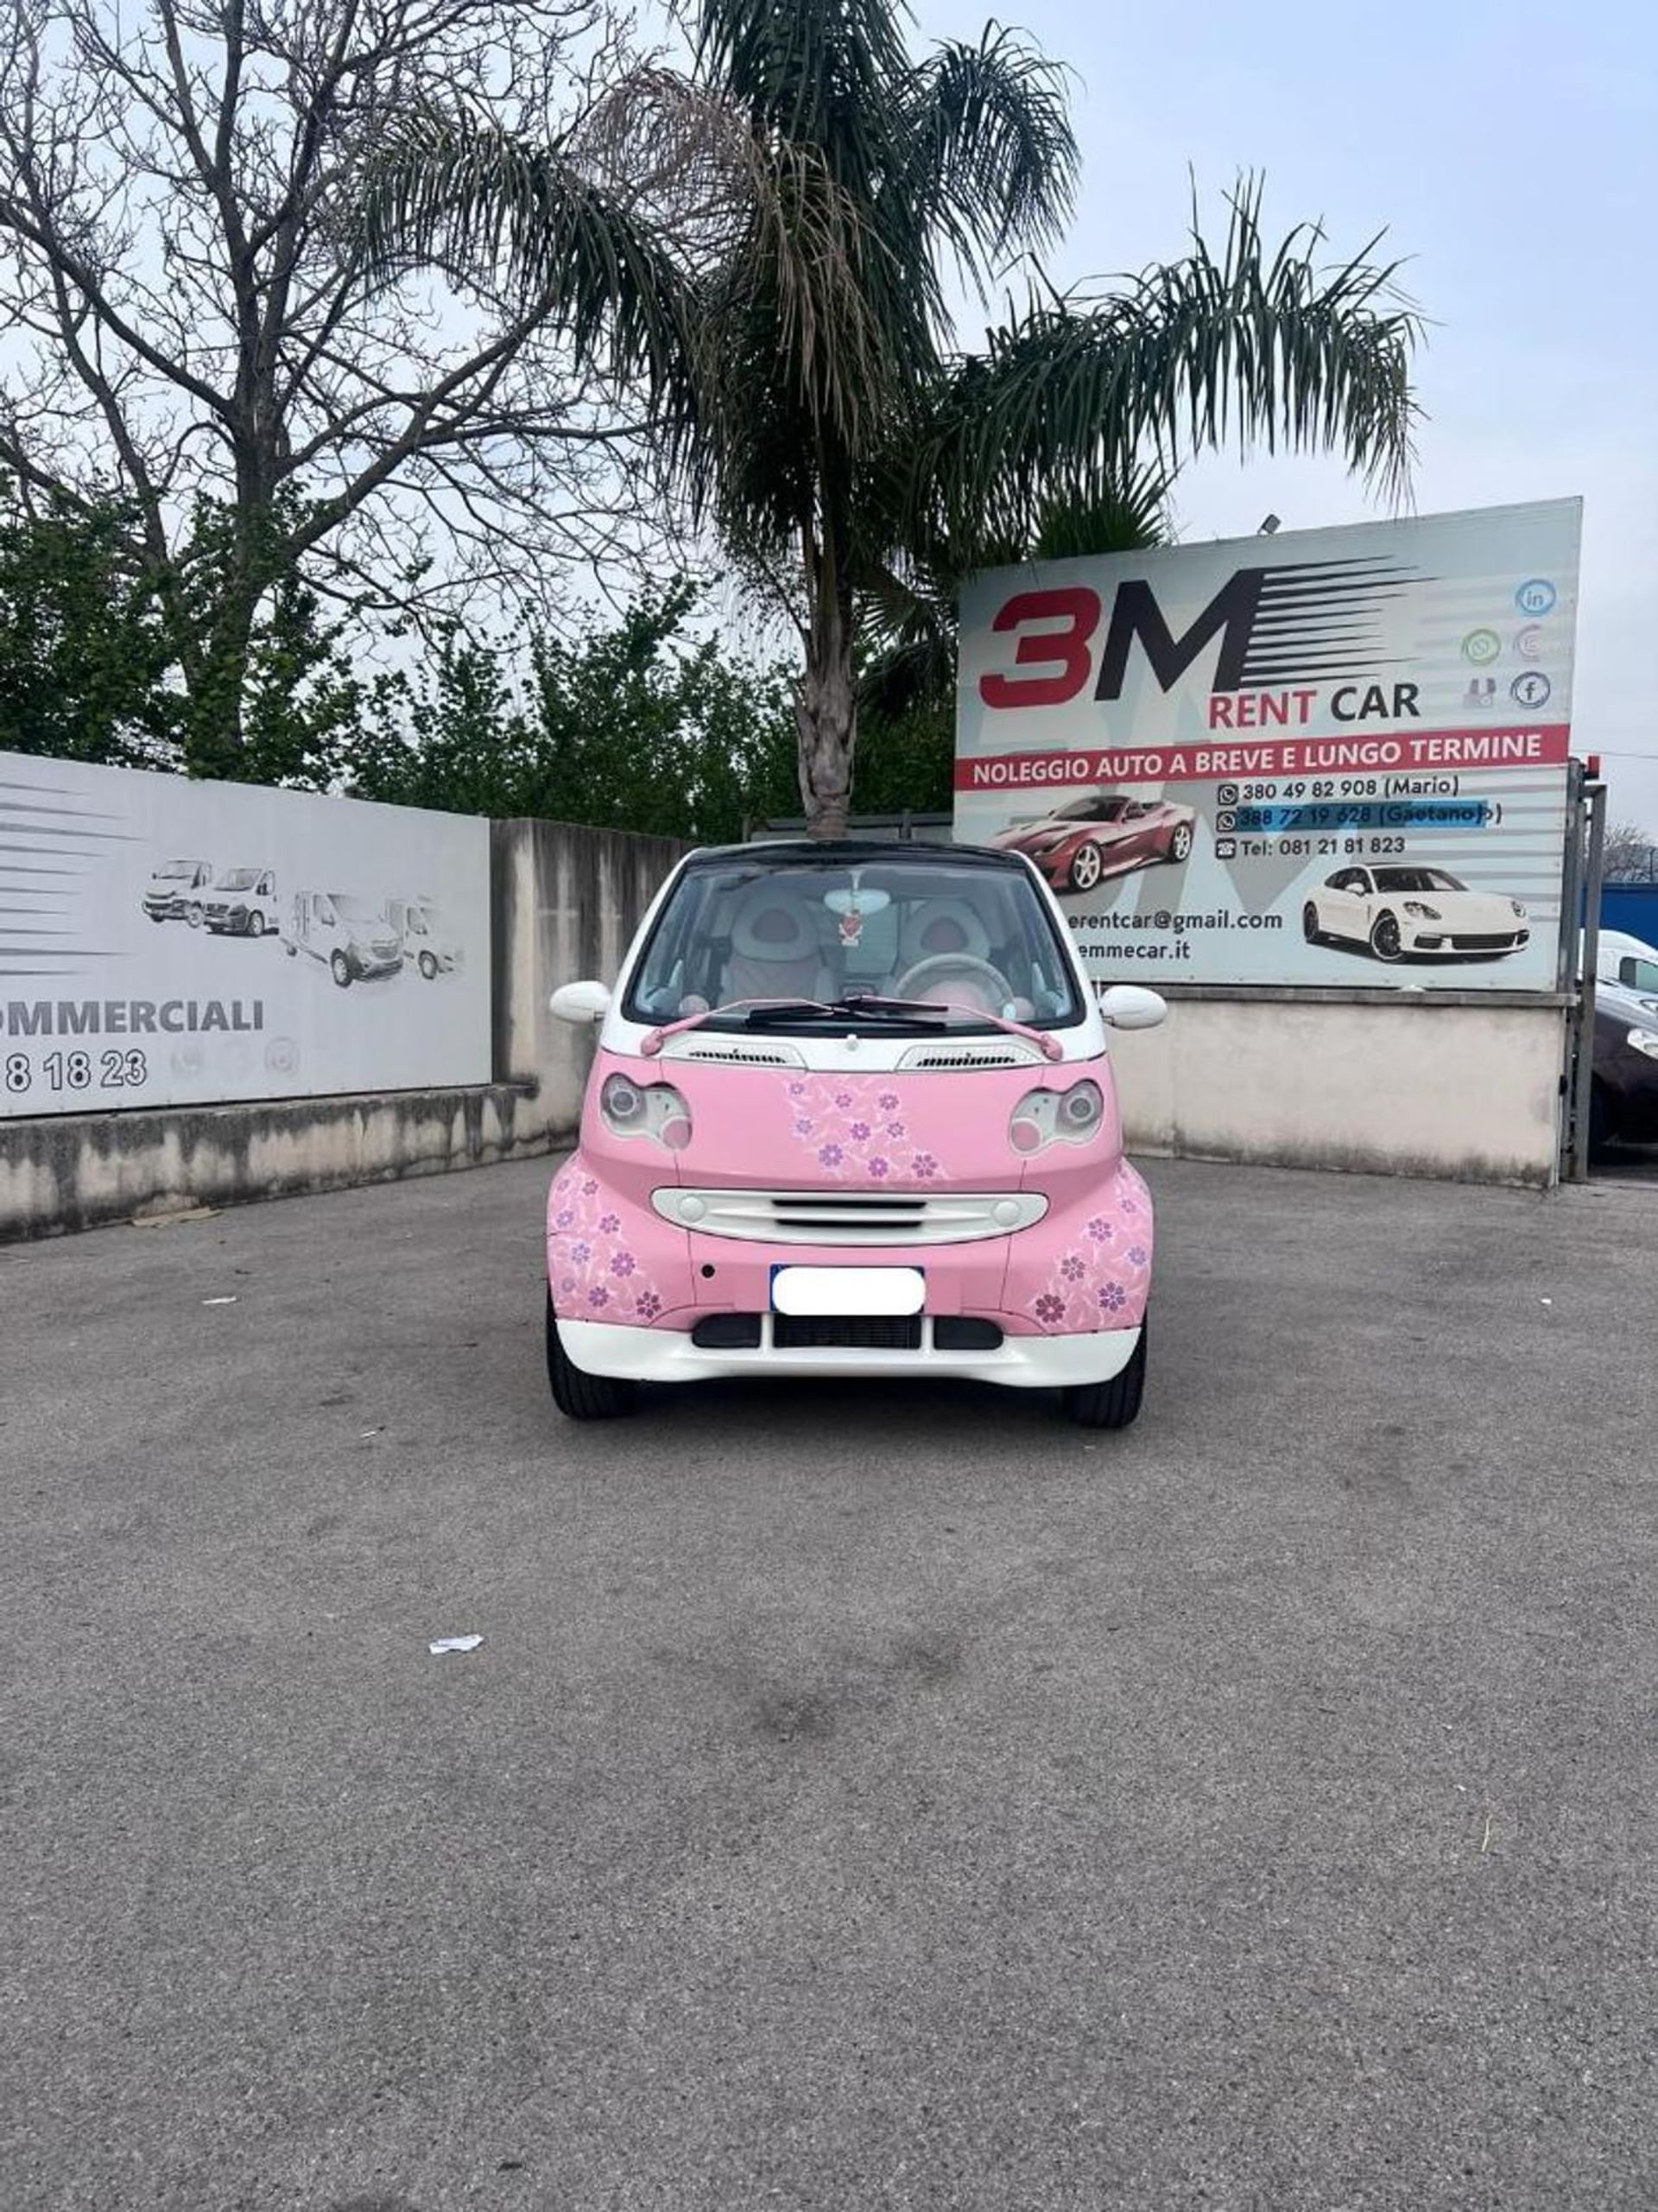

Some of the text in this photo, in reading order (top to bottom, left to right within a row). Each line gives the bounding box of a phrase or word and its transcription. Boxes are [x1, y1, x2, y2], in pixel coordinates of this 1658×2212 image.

[978, 568, 1268, 710] 3M
[1209, 683, 1421, 728] RENT CAR
[973, 733, 1542, 784] NOLEGGIO AUTO A BREVE E LUNGO TERMINE
[1243, 776, 1459, 800] 380 49 82 908 (Mario)
[1241, 837, 1406, 856] Tel: 081 21 81 823
[1068, 910, 1283, 935] erentcar@gmail.com
[1078, 941, 1191, 960] emmecar.it
[6, 1048, 148, 1093] 8 18 23
